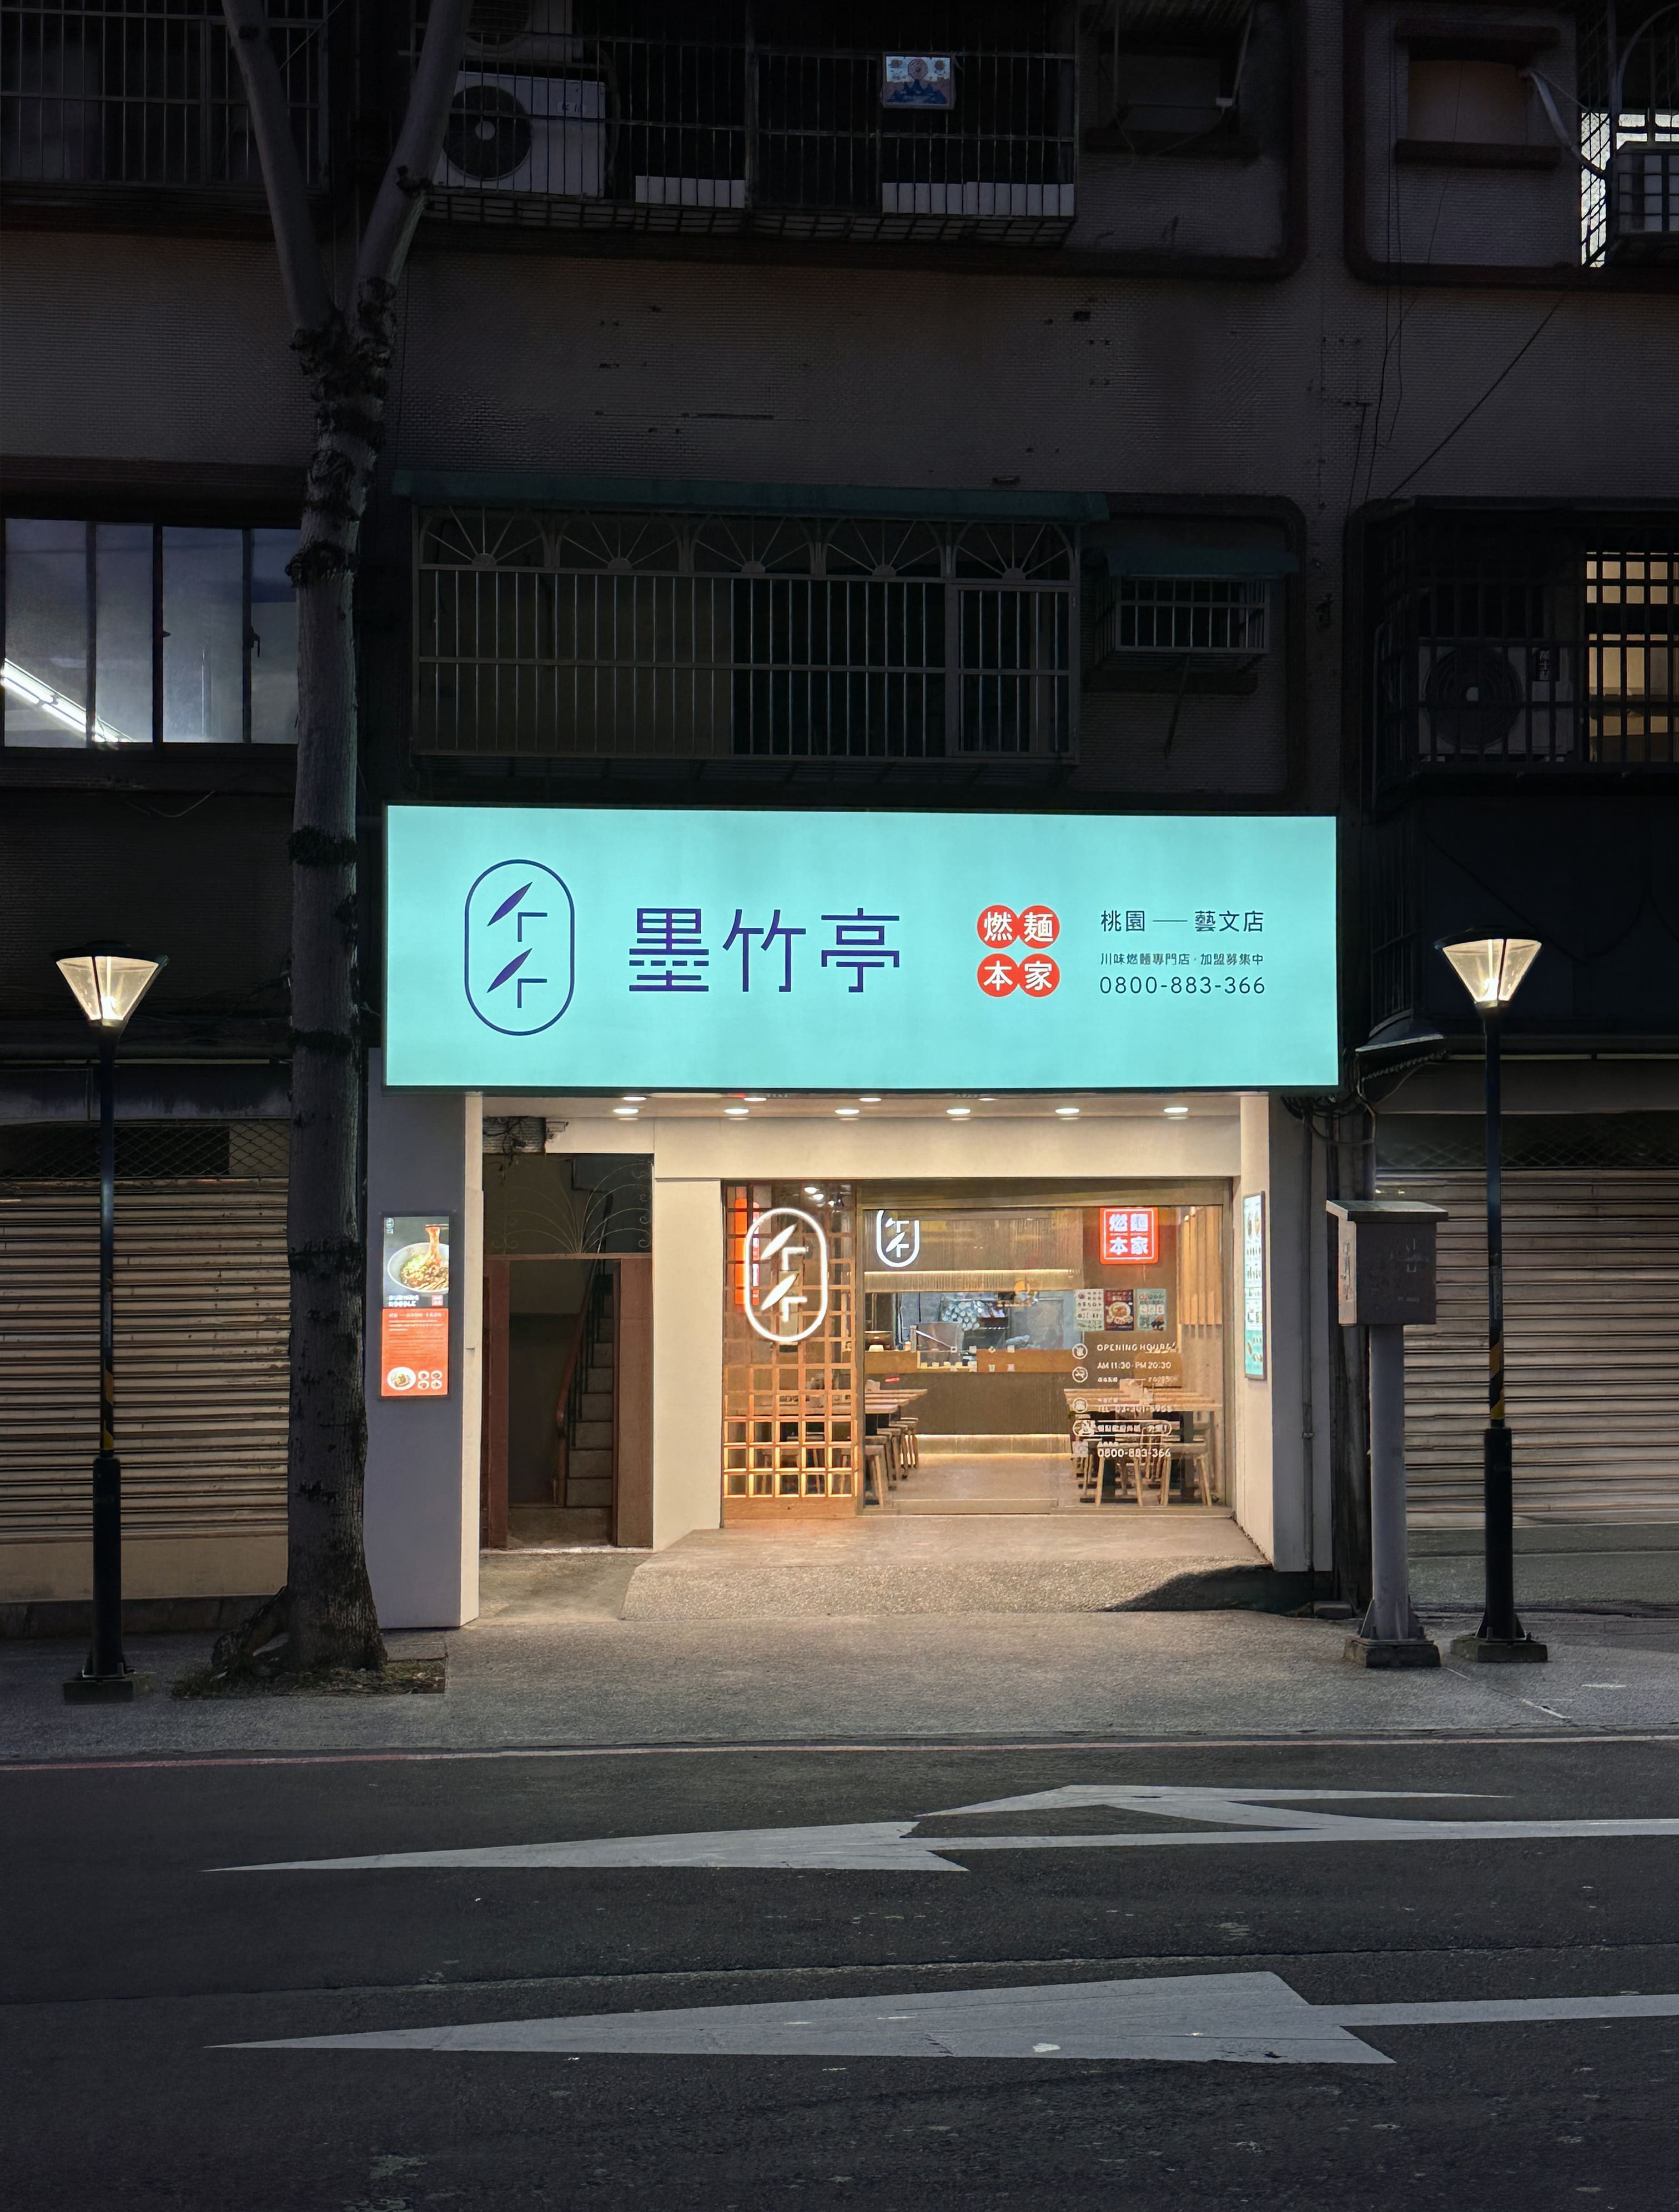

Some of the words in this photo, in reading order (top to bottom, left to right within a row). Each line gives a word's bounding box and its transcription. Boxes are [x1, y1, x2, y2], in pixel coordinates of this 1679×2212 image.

[1100, 909, 1145, 932] 桃園
[1194, 909, 1264, 933] 藝文店
[629, 907, 900, 993] 墨竹亭
[983, 960, 1053, 991] 本家
[1100, 976, 1265, 994] 0800-883-366
